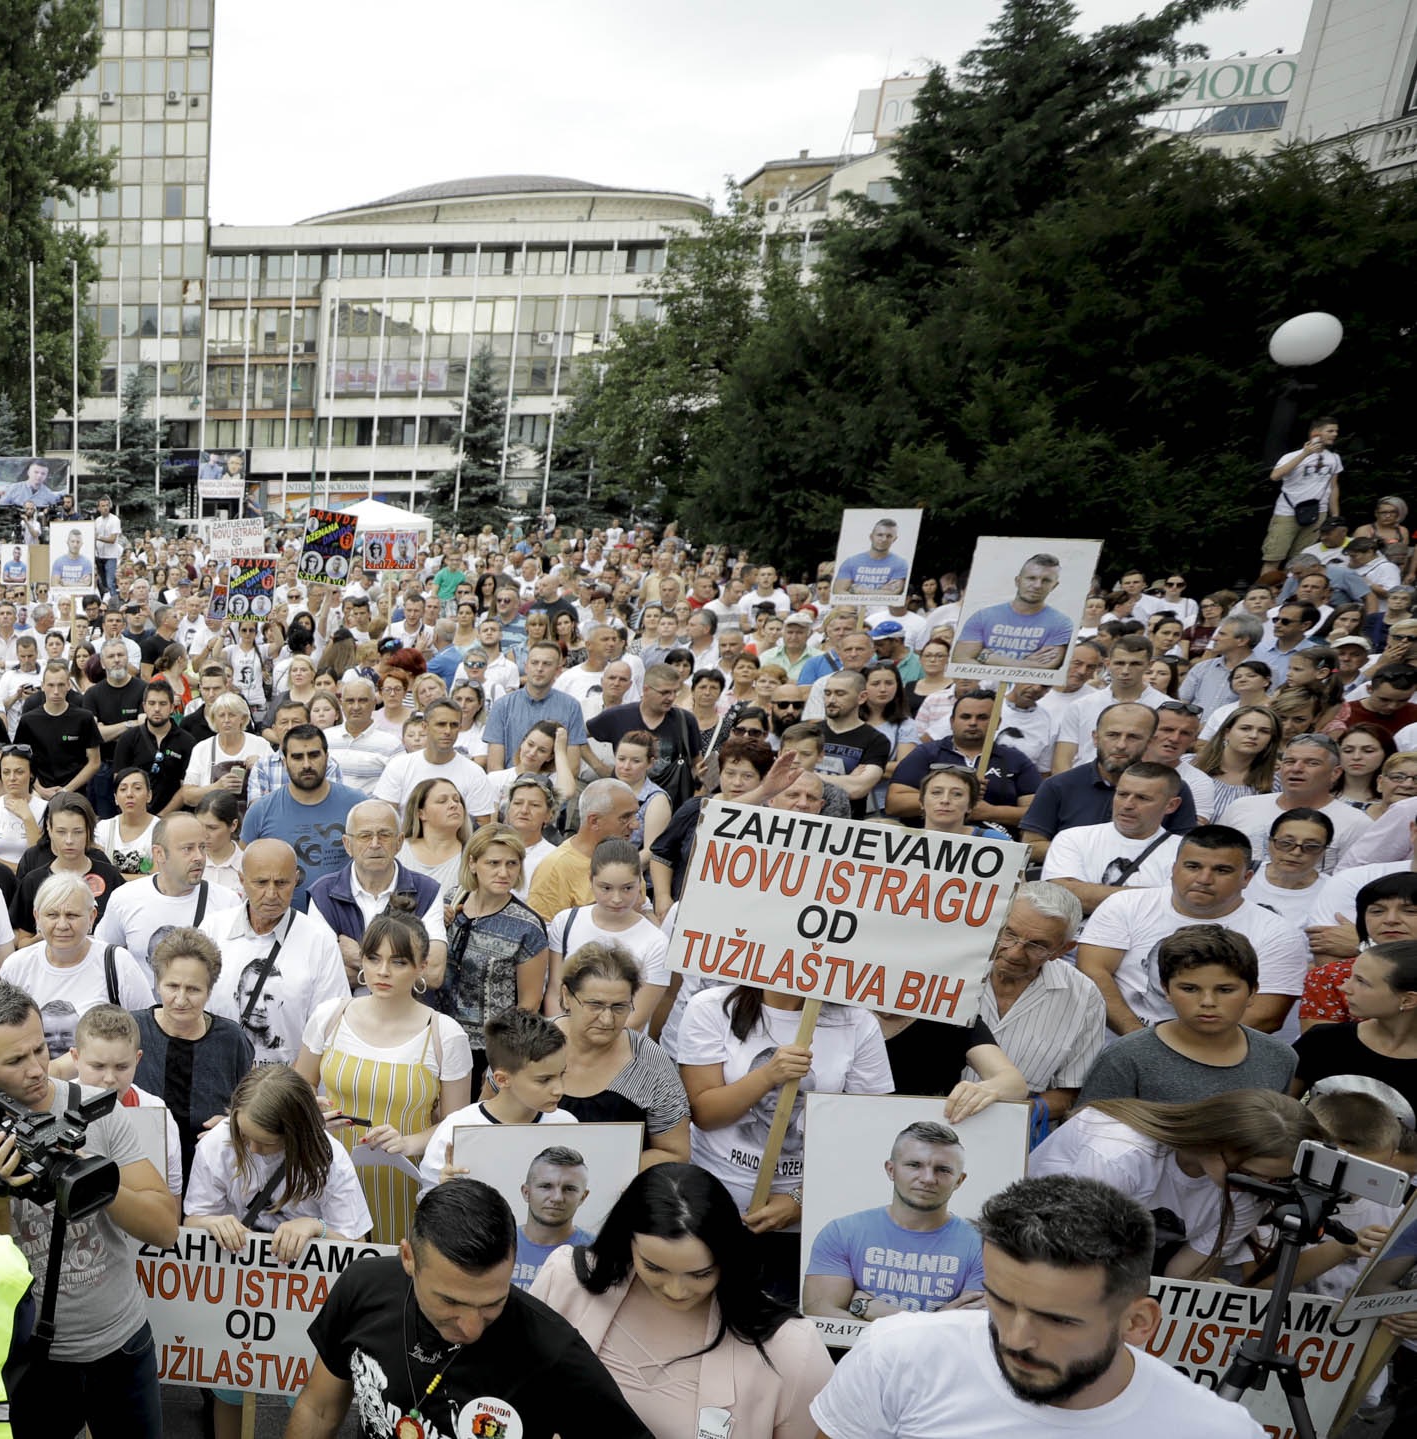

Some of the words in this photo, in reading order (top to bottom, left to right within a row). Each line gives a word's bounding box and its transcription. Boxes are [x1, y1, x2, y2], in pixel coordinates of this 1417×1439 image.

[1123, 60, 1298, 101] NPAOLO
[213, 519, 261, 529] ZAHTIJEVAMO
[310, 508, 358, 526] PRAVDA
[213, 528, 230, 539] NOVU
[232, 526, 262, 538] ISTRAGU
[231, 538, 242, 546] OD
[231, 558, 277, 568] PRAVDA
[988, 635, 1040, 651] FINALS
[992, 624, 1046, 638] GRAND
[954, 666, 991, 675] PRAVDA
[713, 807, 1005, 878] ZAHTIJEVAMO
[699, 839, 811, 898] NOVU
[814, 858, 1000, 928] ISTRAGU
[797, 904, 858, 944] OD
[682, 927, 886, 1006] TUŽILAŠTVA
[894, 970, 966, 1019] BIH
[730, 1148, 760, 1170] PRAVD
[864, 1246, 960, 1275] GRAND
[136, 1259, 225, 1304] NOVU
[235, 1268, 330, 1313] ISTRA
[862, 1267, 955, 1298] FINALS
[1354, 1294, 1412, 1311] PRAVDA
[225, 1309, 276, 1342] OD
[158, 1336, 310, 1392] UŽILAŠTVA
